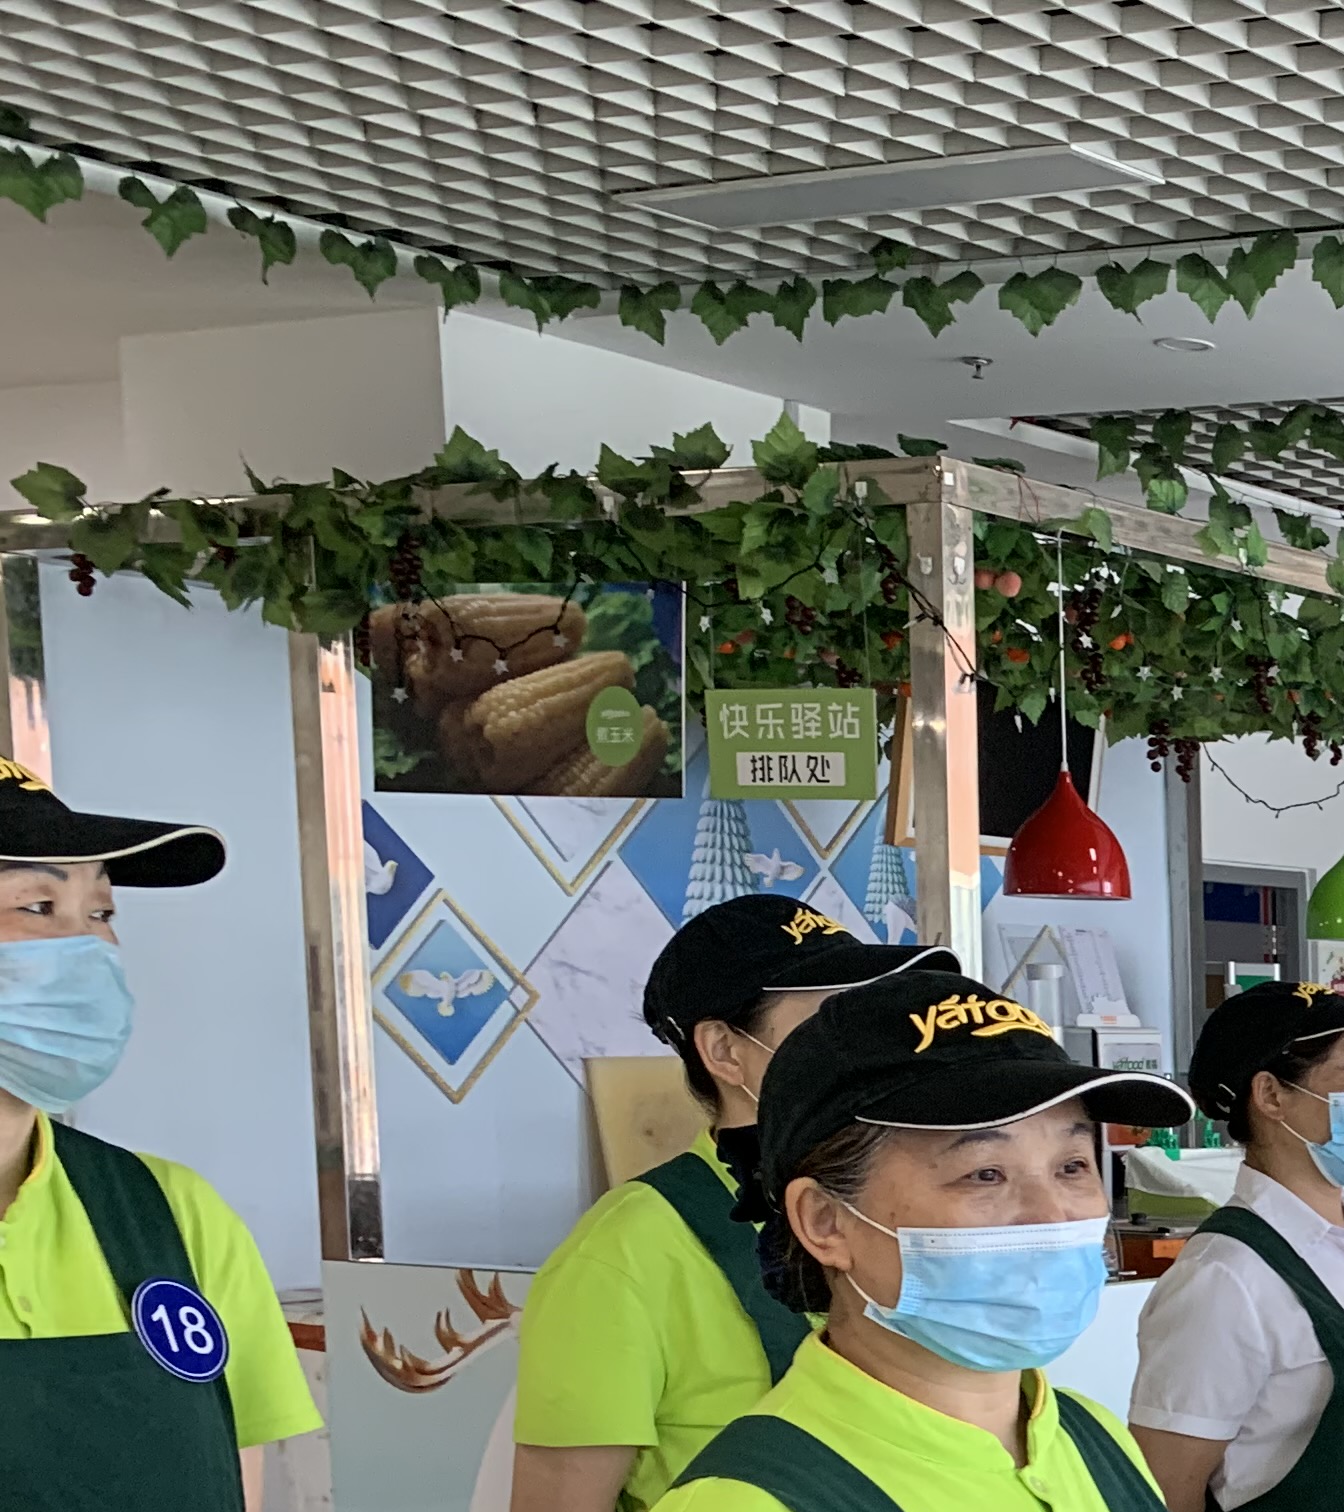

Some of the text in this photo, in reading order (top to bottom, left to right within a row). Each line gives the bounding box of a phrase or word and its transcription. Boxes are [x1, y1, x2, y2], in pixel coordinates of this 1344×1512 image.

[719, 702, 861, 740] 快乐驿站
[750, 754, 831, 784] 排队处
[151, 1304, 214, 1354] 18
